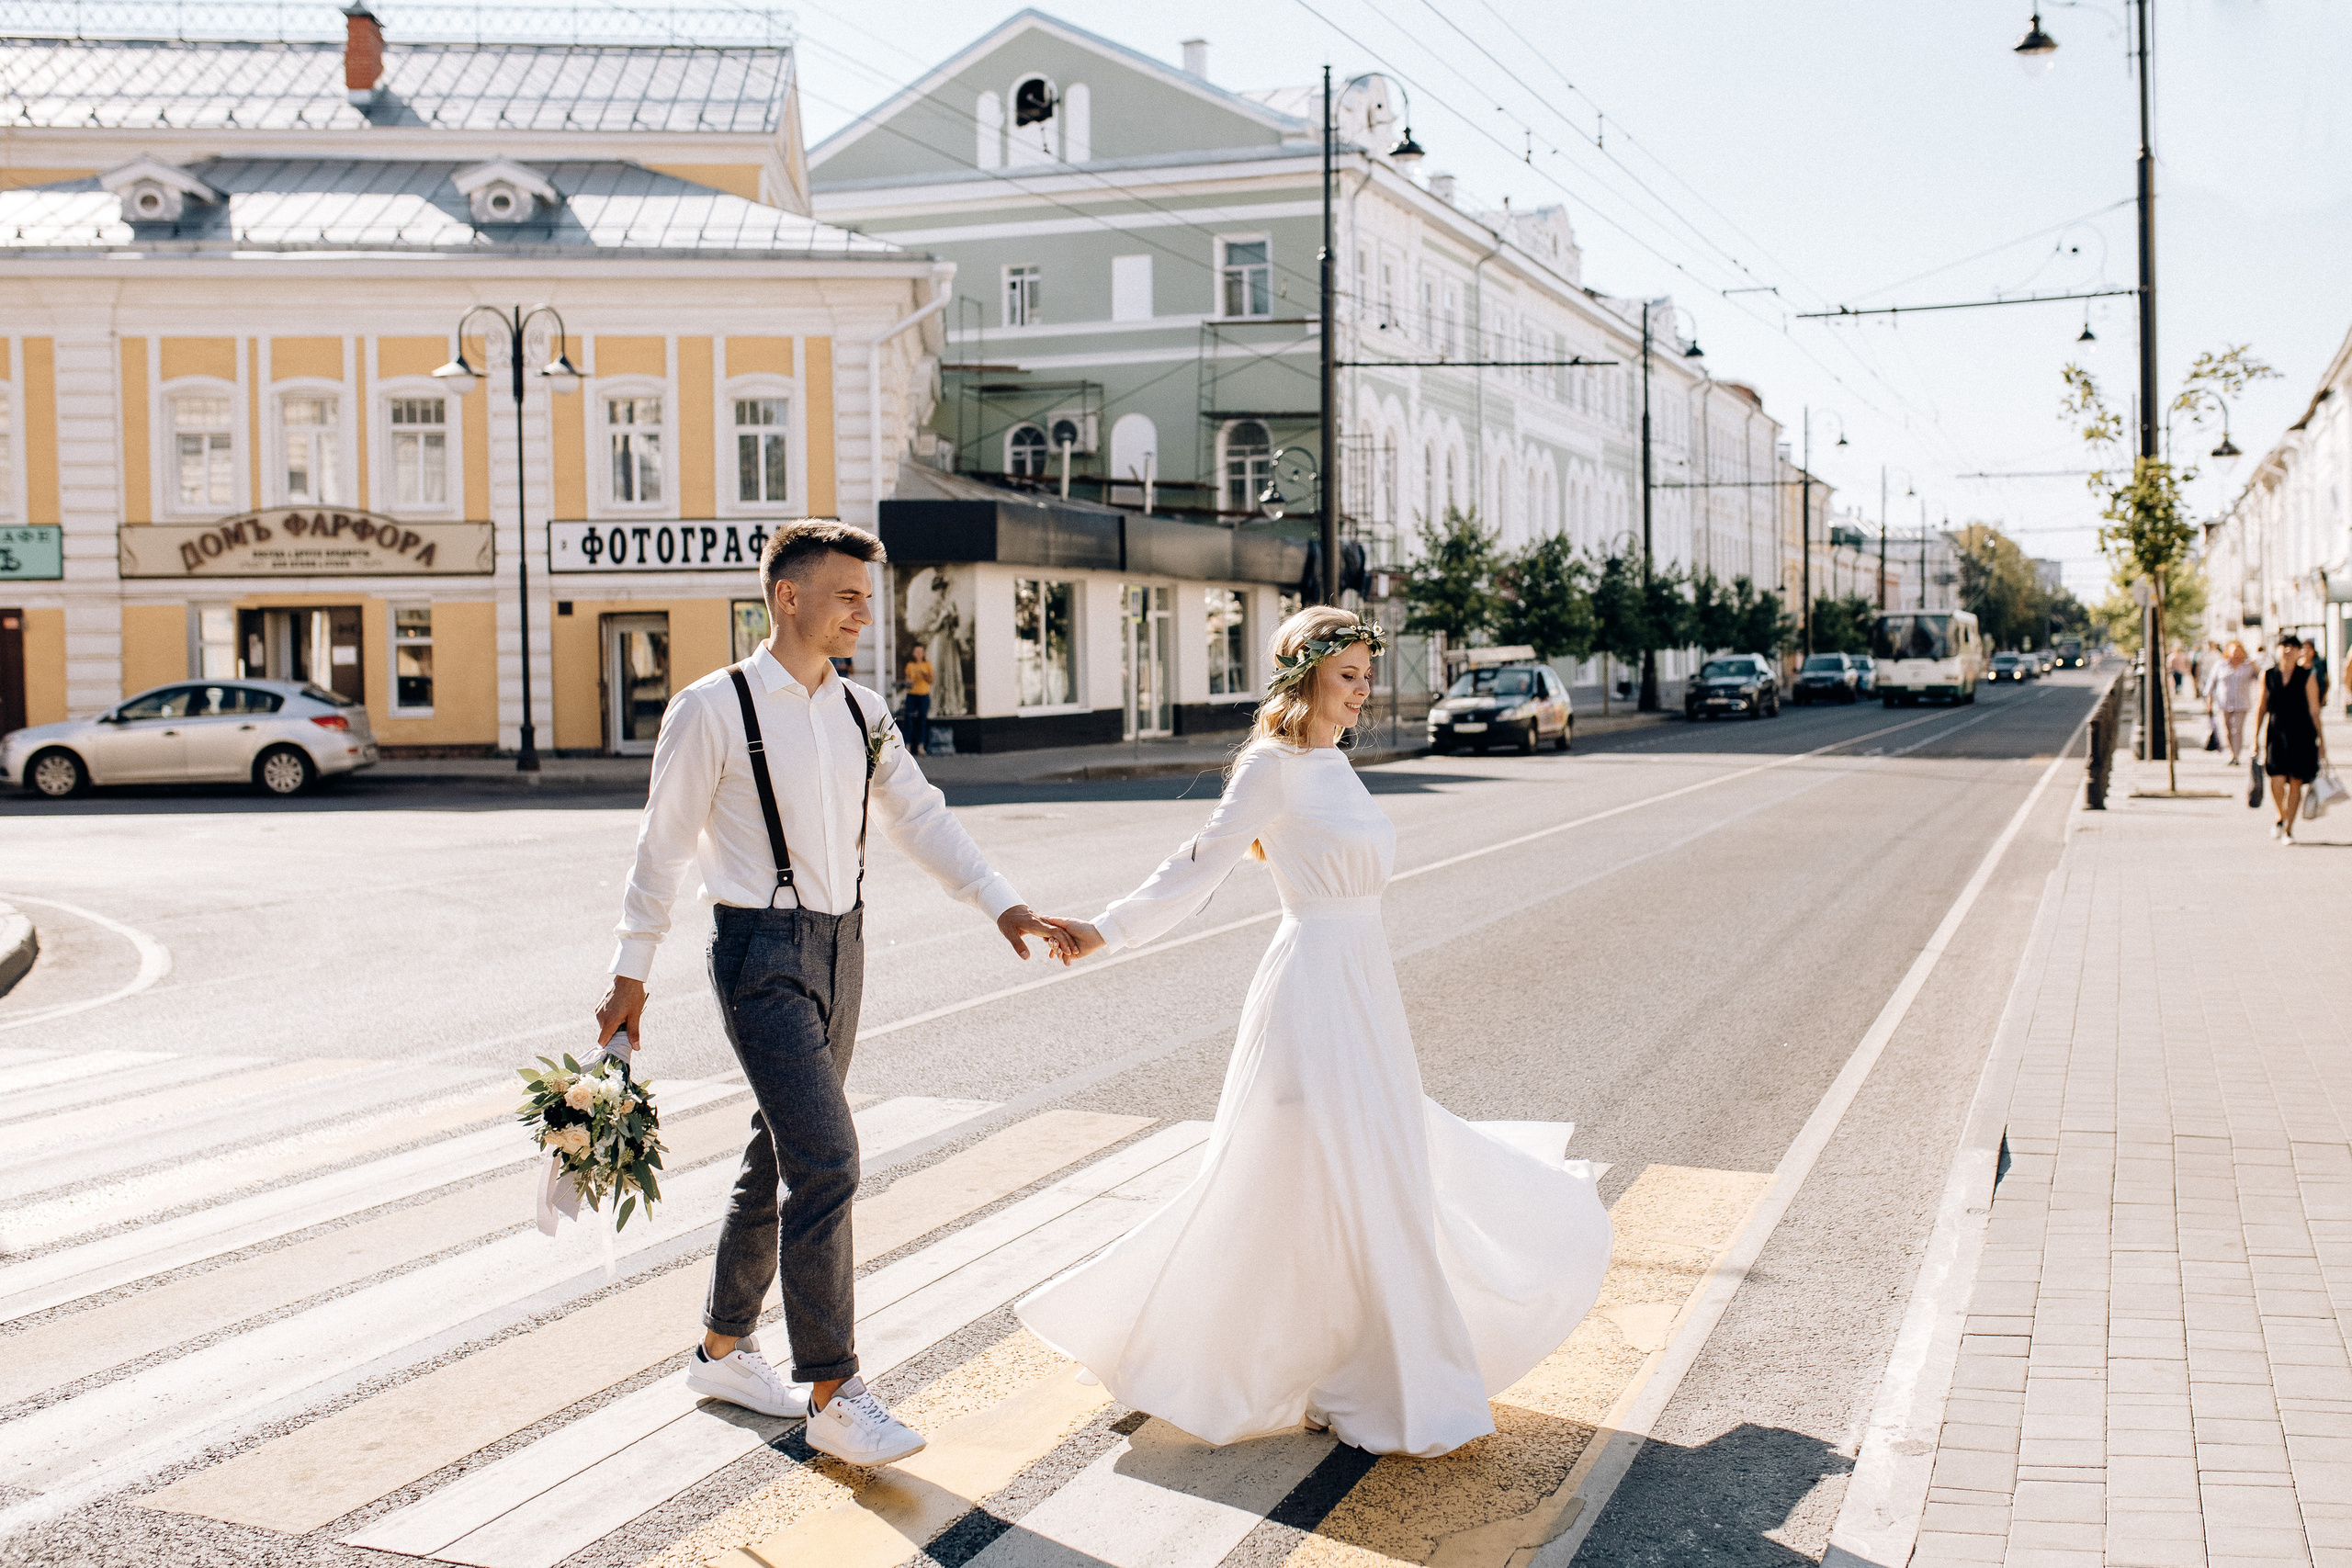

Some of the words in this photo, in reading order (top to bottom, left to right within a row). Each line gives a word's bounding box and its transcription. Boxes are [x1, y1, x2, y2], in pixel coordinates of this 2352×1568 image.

[0, 531, 51, 544] АФЕ
[180, 518, 272, 571] ДОМЪ
[283, 513, 436, 567] ФАРФОРА
[581, 525, 780, 564] ФОТОГРАФ
